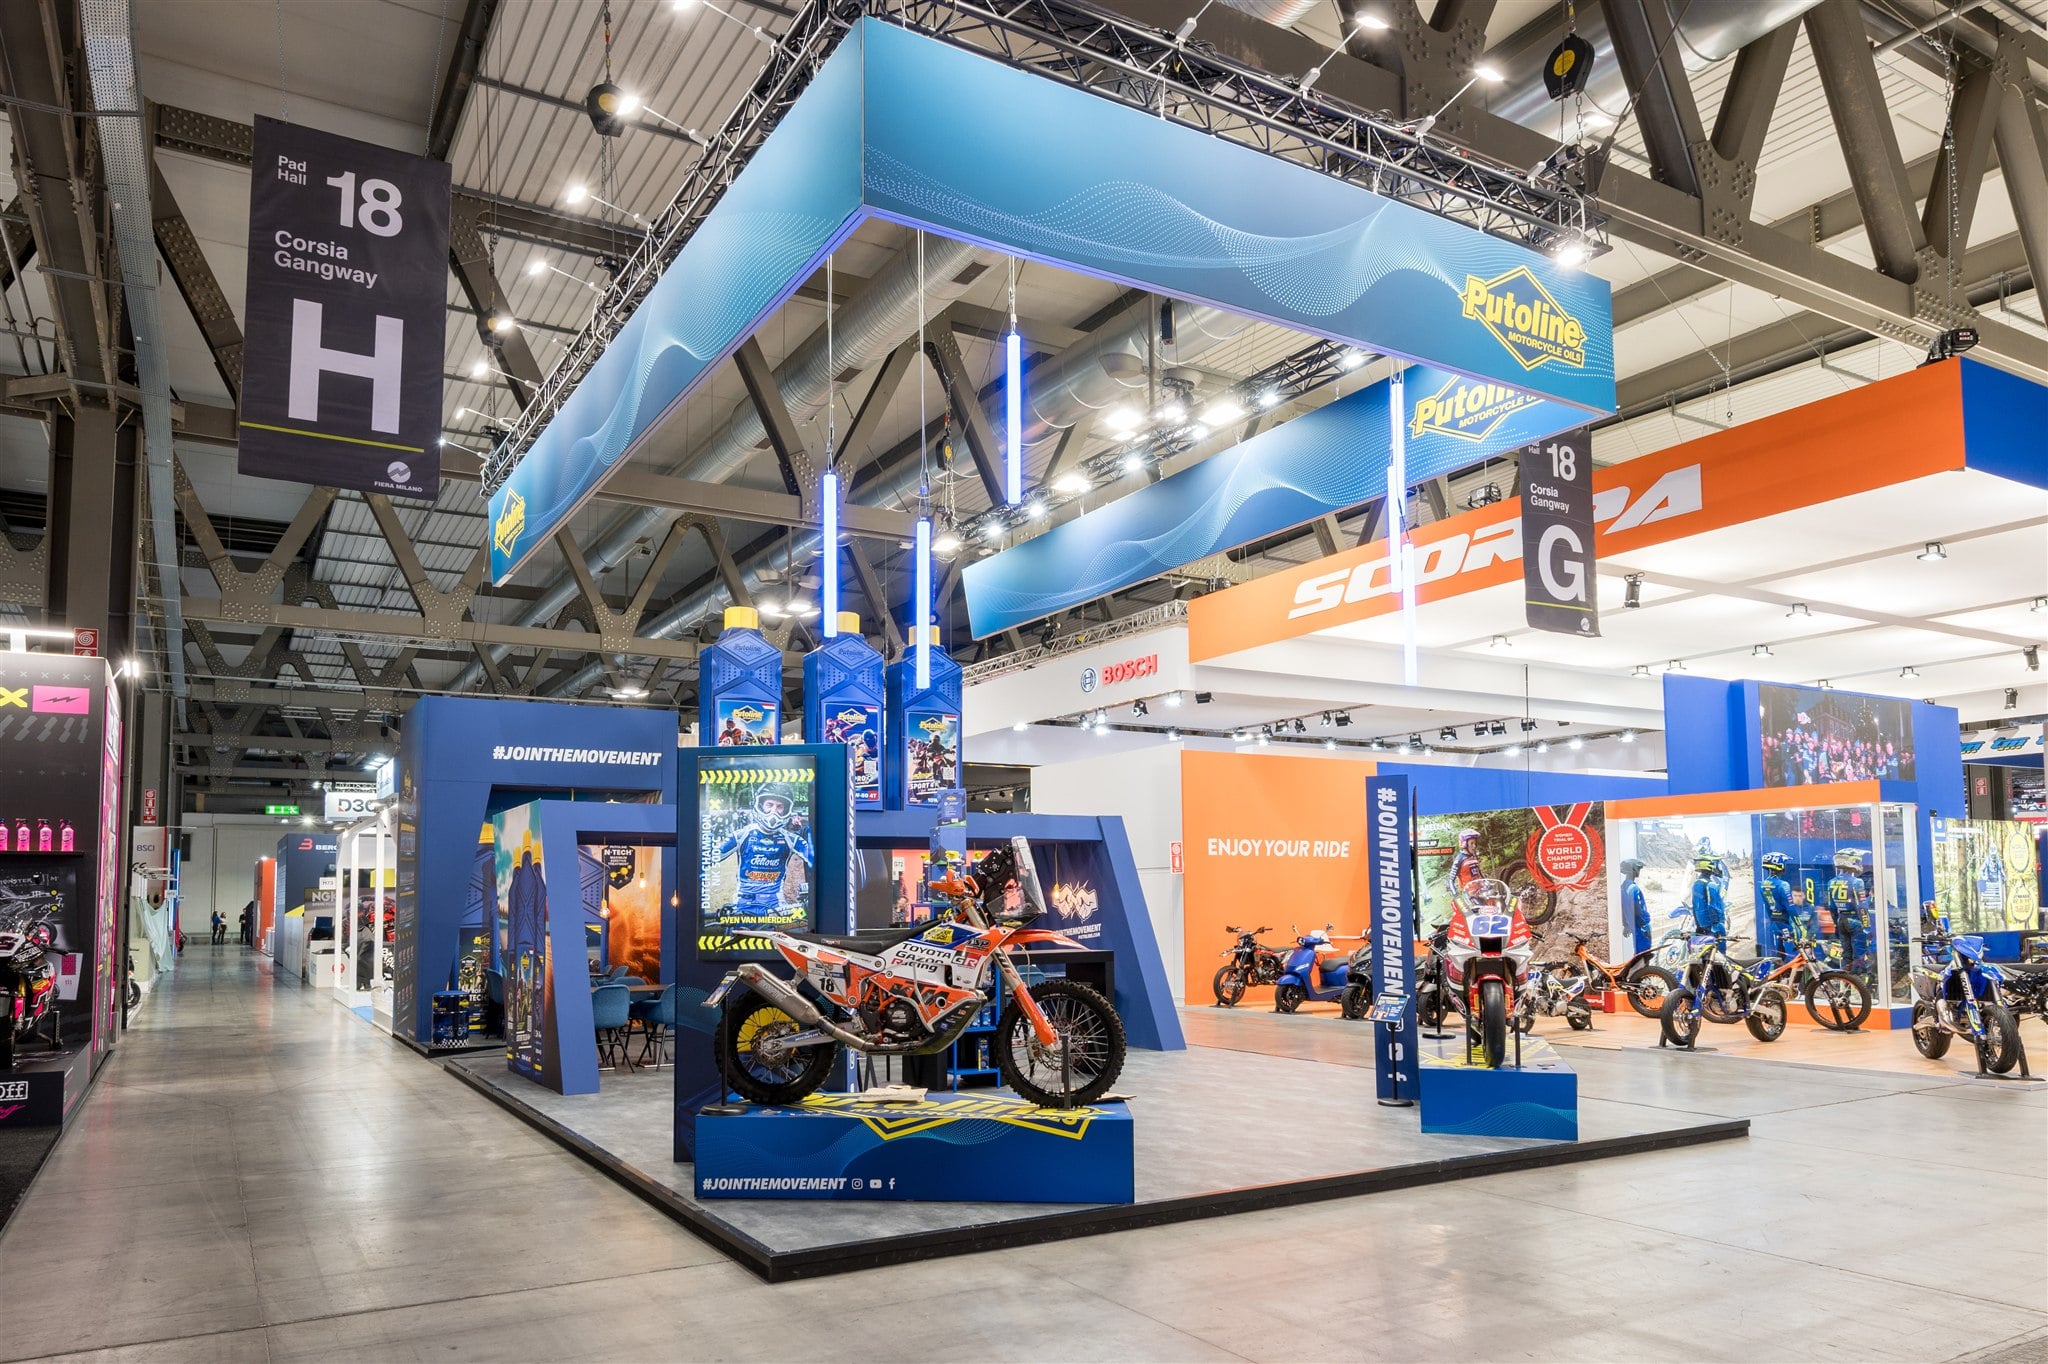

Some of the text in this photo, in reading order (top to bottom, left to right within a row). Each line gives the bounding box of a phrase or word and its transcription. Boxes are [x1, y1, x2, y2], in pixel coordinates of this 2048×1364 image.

[278, 155, 307, 172] Pad
[277, 168, 307, 186] Hall
[326, 170, 403, 238] 18
[274, 230, 349, 261] Corsia
[273, 250, 378, 289] Gangway
[1464, 275, 1584, 348] Putoline
[1508, 331, 1582, 362] MOTORCYCLE OILS
[287, 298, 404, 435] H
[1458, 395, 1524, 429] MOTORCYCLE
[1528, 446, 1541, 455] Hall
[1546, 443, 1577, 482] 18
[1530, 482, 1559, 499] Corsia
[1530, 494, 1570, 514] Gangway
[1538, 524, 1586, 602] G
[1101, 654, 1158, 685] BOSCH
[493, 745, 662, 766] #JOINTHEMOVEMENT
[702, 815, 711, 873] CHAMPION
[1208, 838, 1350, 858] ENJOY YOUR RIDE
[1547, 847, 1582, 855] WORLD
[1552, 862, 1577, 870] 2025
[1377, 787, 1404, 994] #JOINTHEMOVEMEN
[1830, 885, 1848, 900] 76
[757, 916, 793, 924] MIERDEN
[1472, 916, 1509, 935] 62
[902, 943, 951, 959] TOYOTA
[819, 978, 835, 992] 18
[703, 1178, 847, 1191] #JOINTHEMOVEMENT
